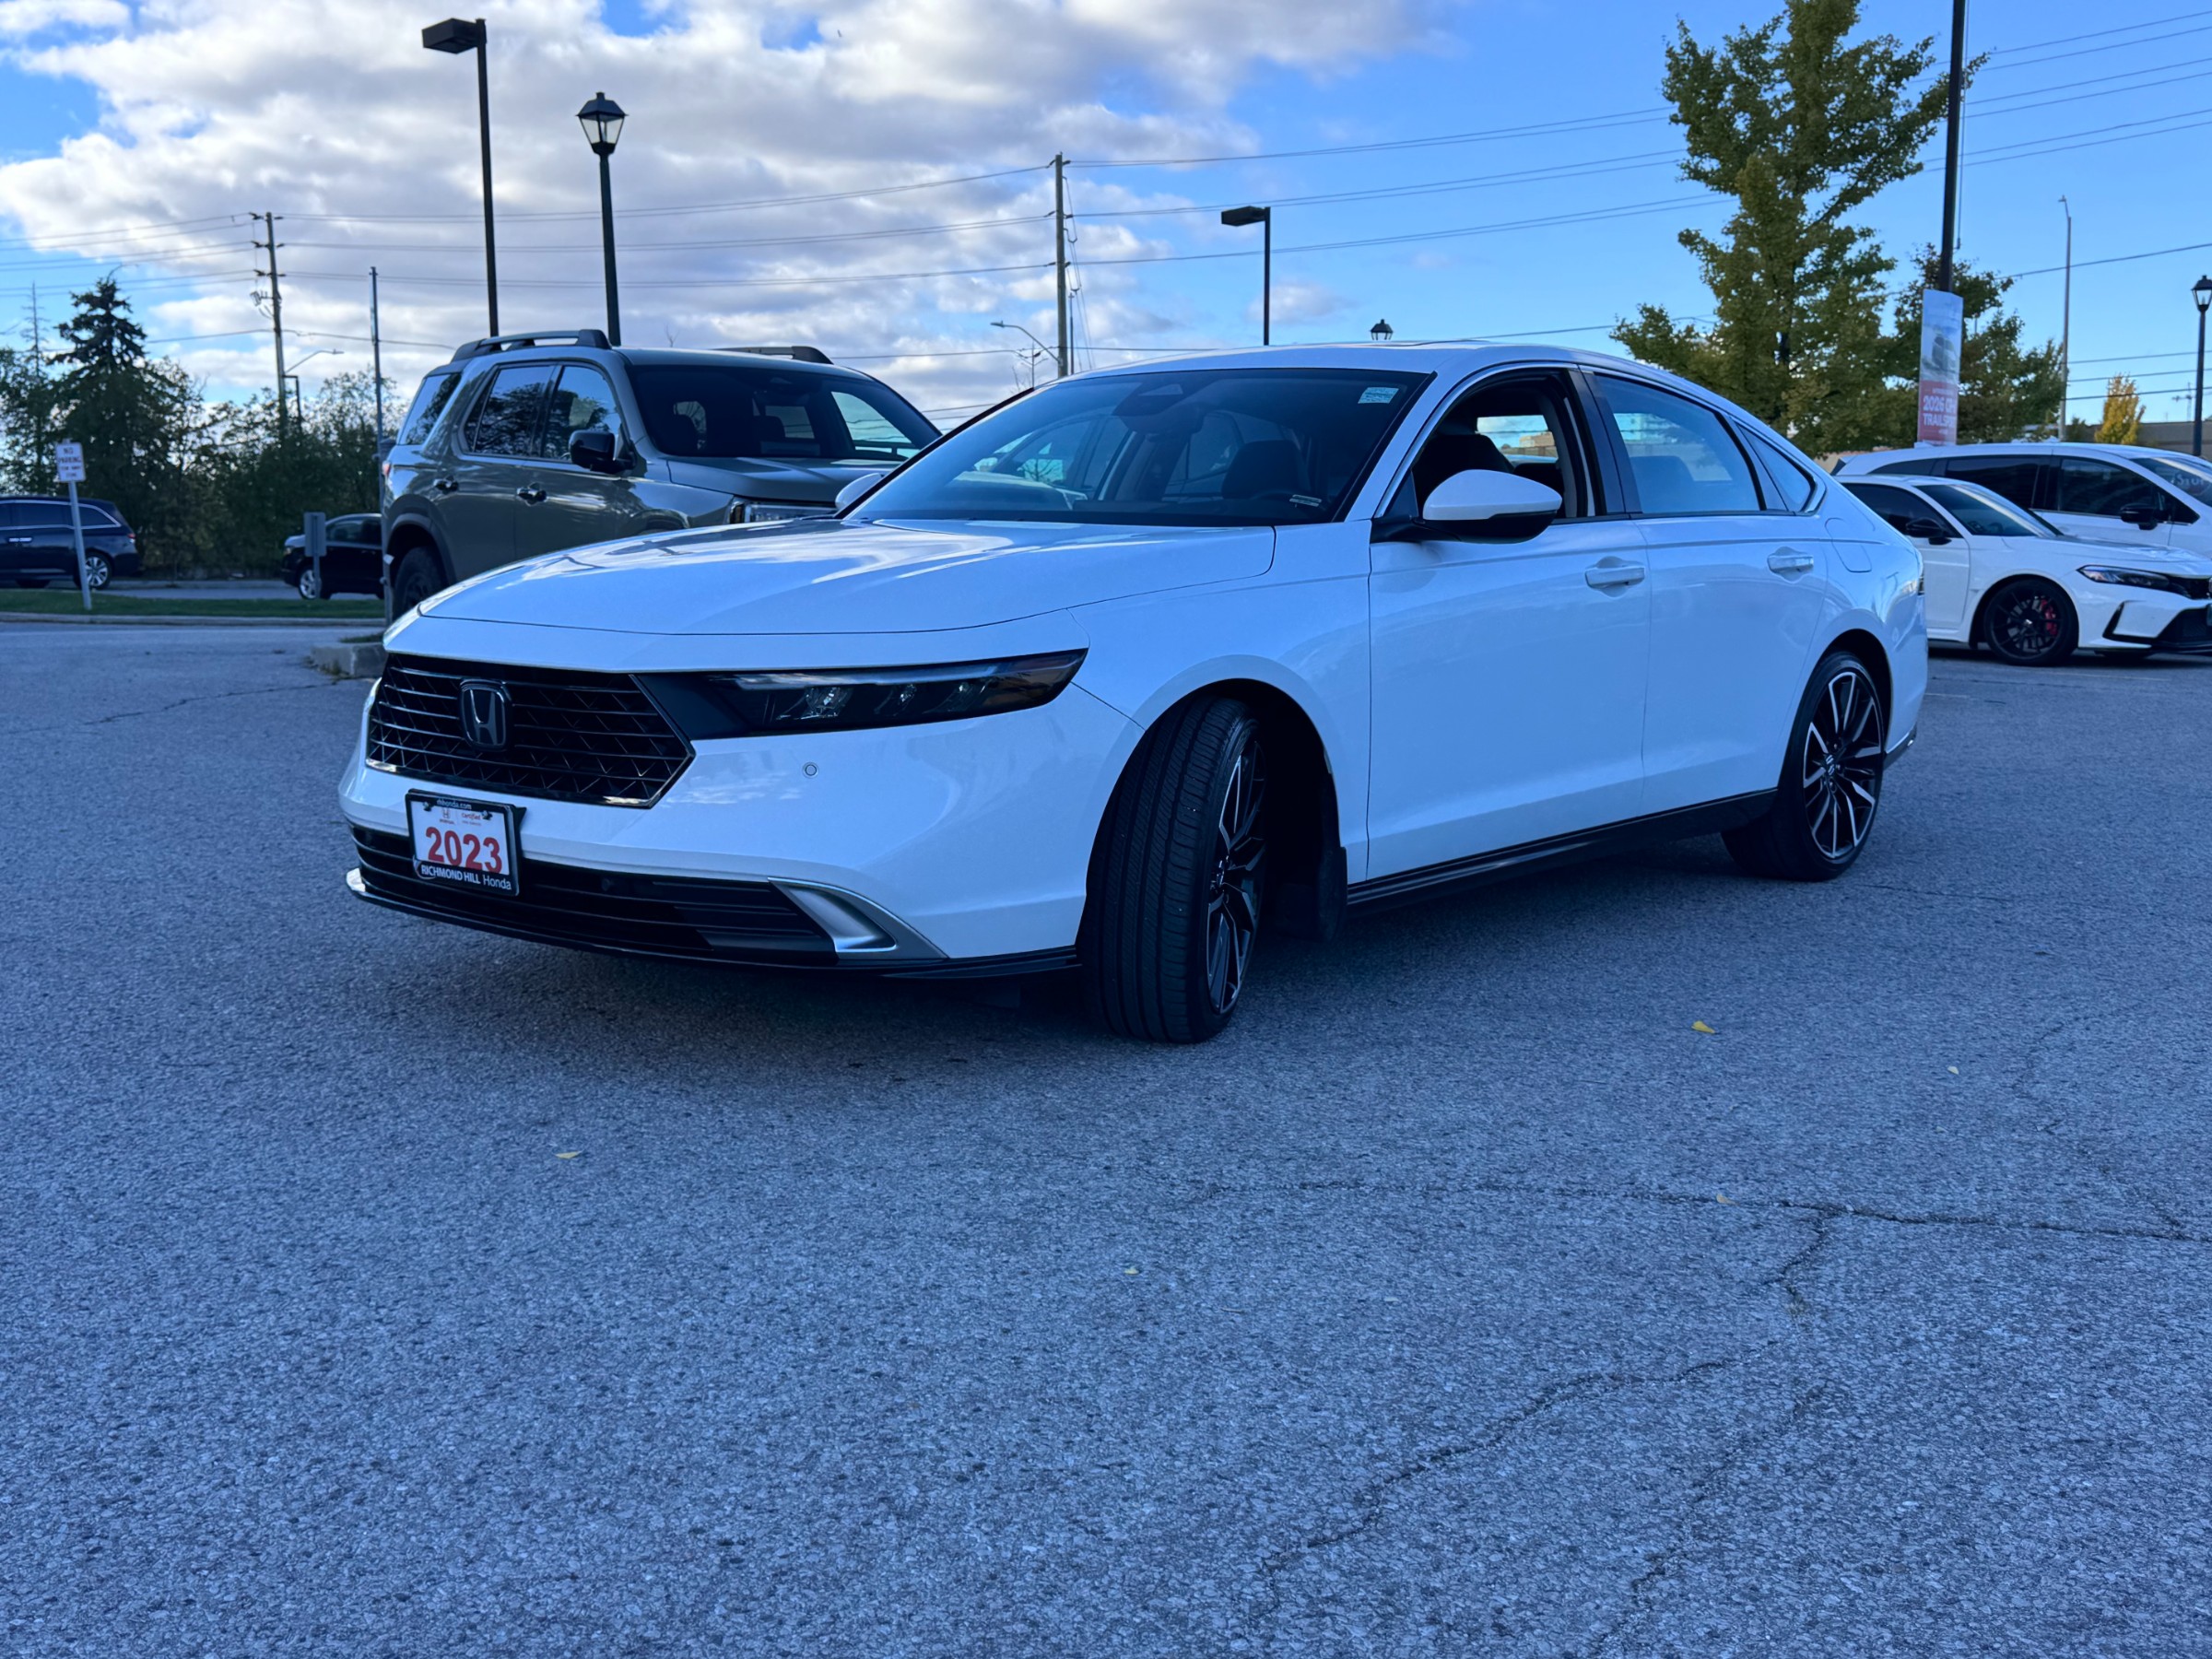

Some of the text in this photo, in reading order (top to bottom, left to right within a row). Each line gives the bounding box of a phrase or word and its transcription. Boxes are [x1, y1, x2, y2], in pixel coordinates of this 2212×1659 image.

[1923, 395, 1944, 412] 2026
[426, 826, 502, 874] 2023
[421, 865, 512, 890] RICHMOND HILL Honda
